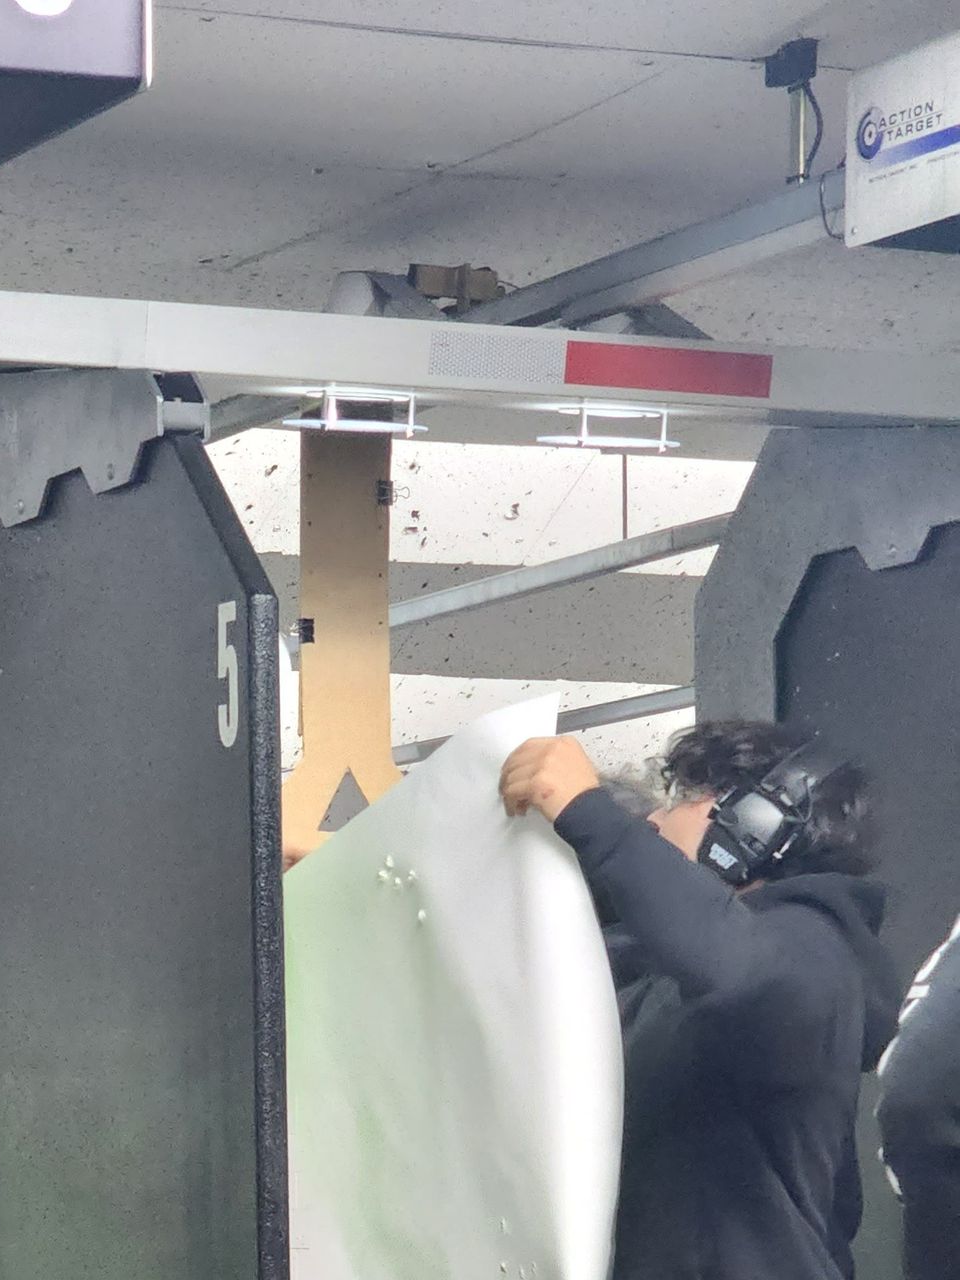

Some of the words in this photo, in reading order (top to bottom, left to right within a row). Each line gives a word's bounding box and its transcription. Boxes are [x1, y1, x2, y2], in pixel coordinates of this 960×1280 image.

[879, 100, 934, 129] ACTION
[887, 113, 942, 141] TARGET
[218, 600, 238, 747] 5
